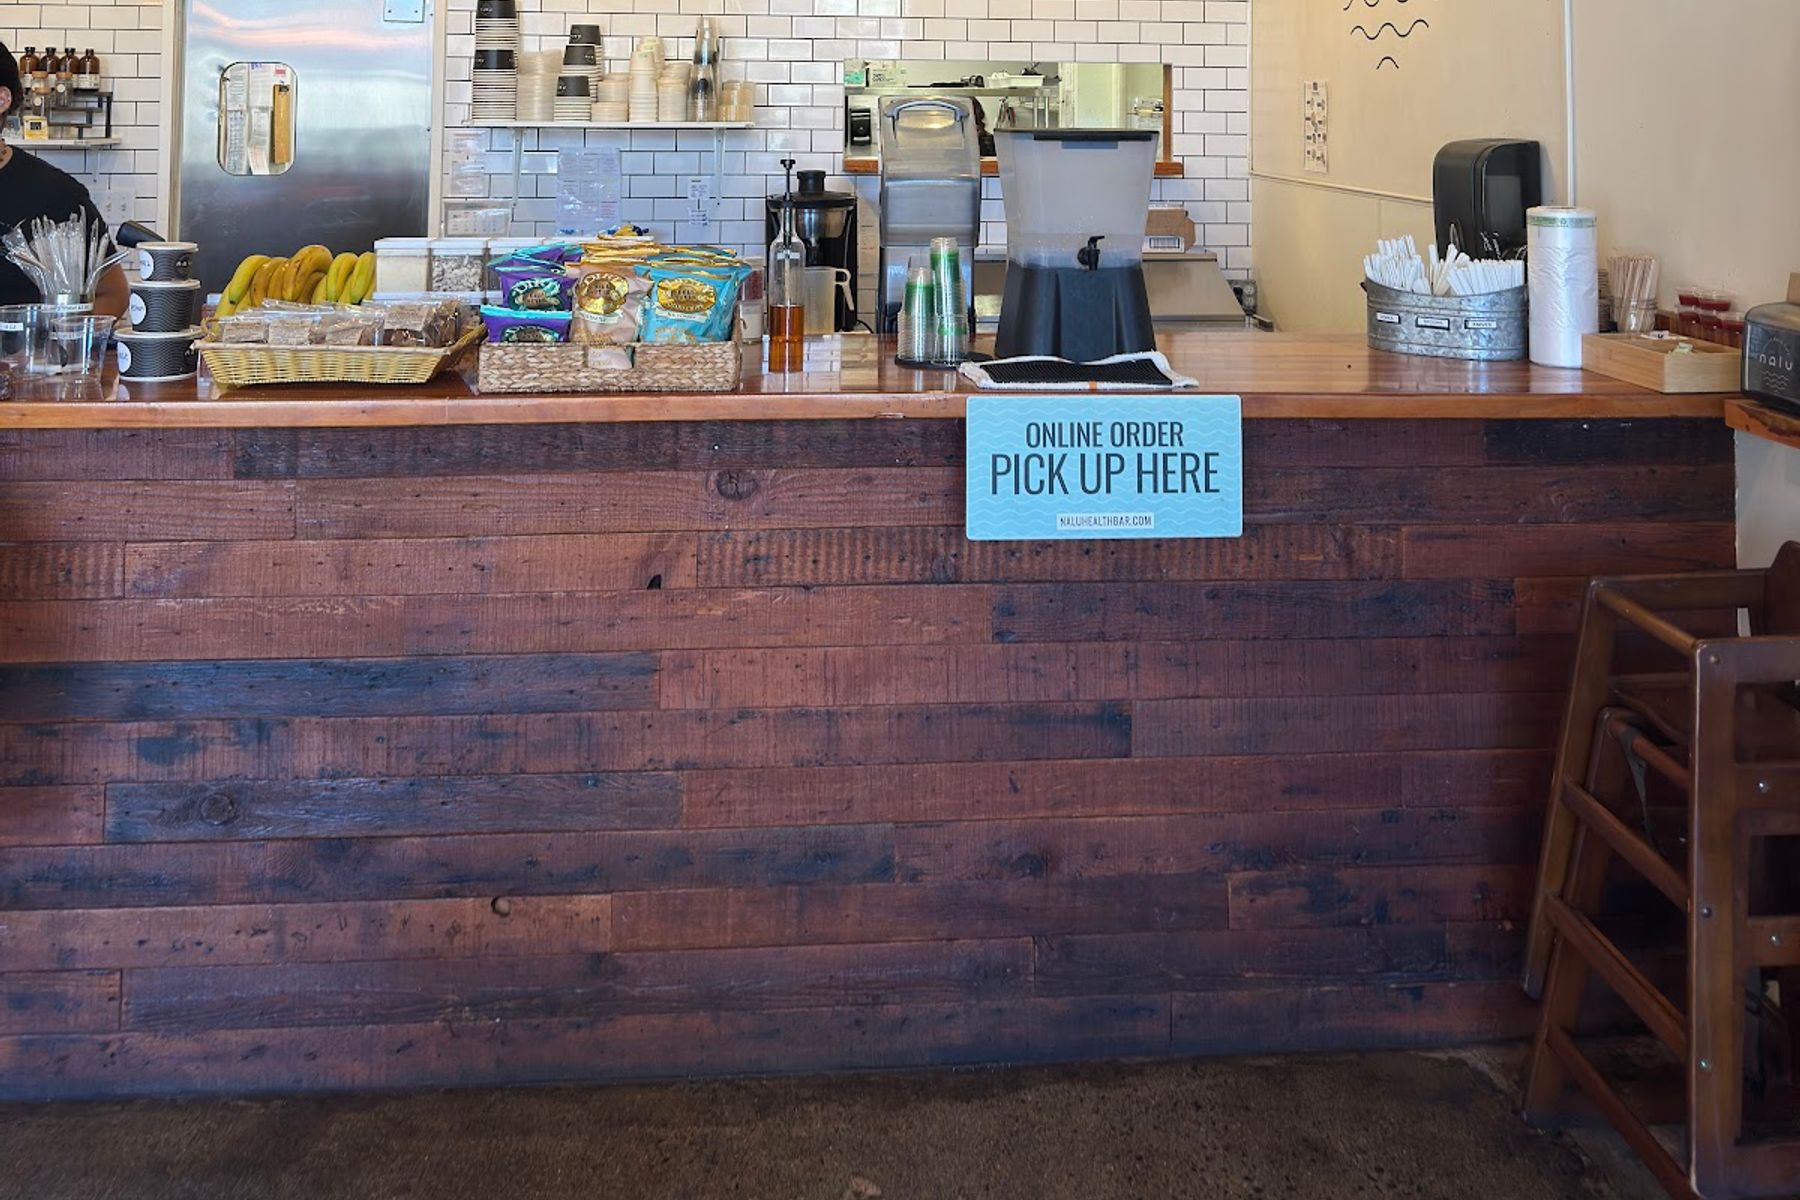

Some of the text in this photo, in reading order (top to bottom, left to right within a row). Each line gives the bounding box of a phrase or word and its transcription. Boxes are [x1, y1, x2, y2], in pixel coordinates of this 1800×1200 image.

[1026, 421, 1184, 448] ONLINE ORDER
[991, 452, 1220, 495] PICK UP HERE
[1060, 515, 1152, 527] NALUHEALTHBAR.COM
